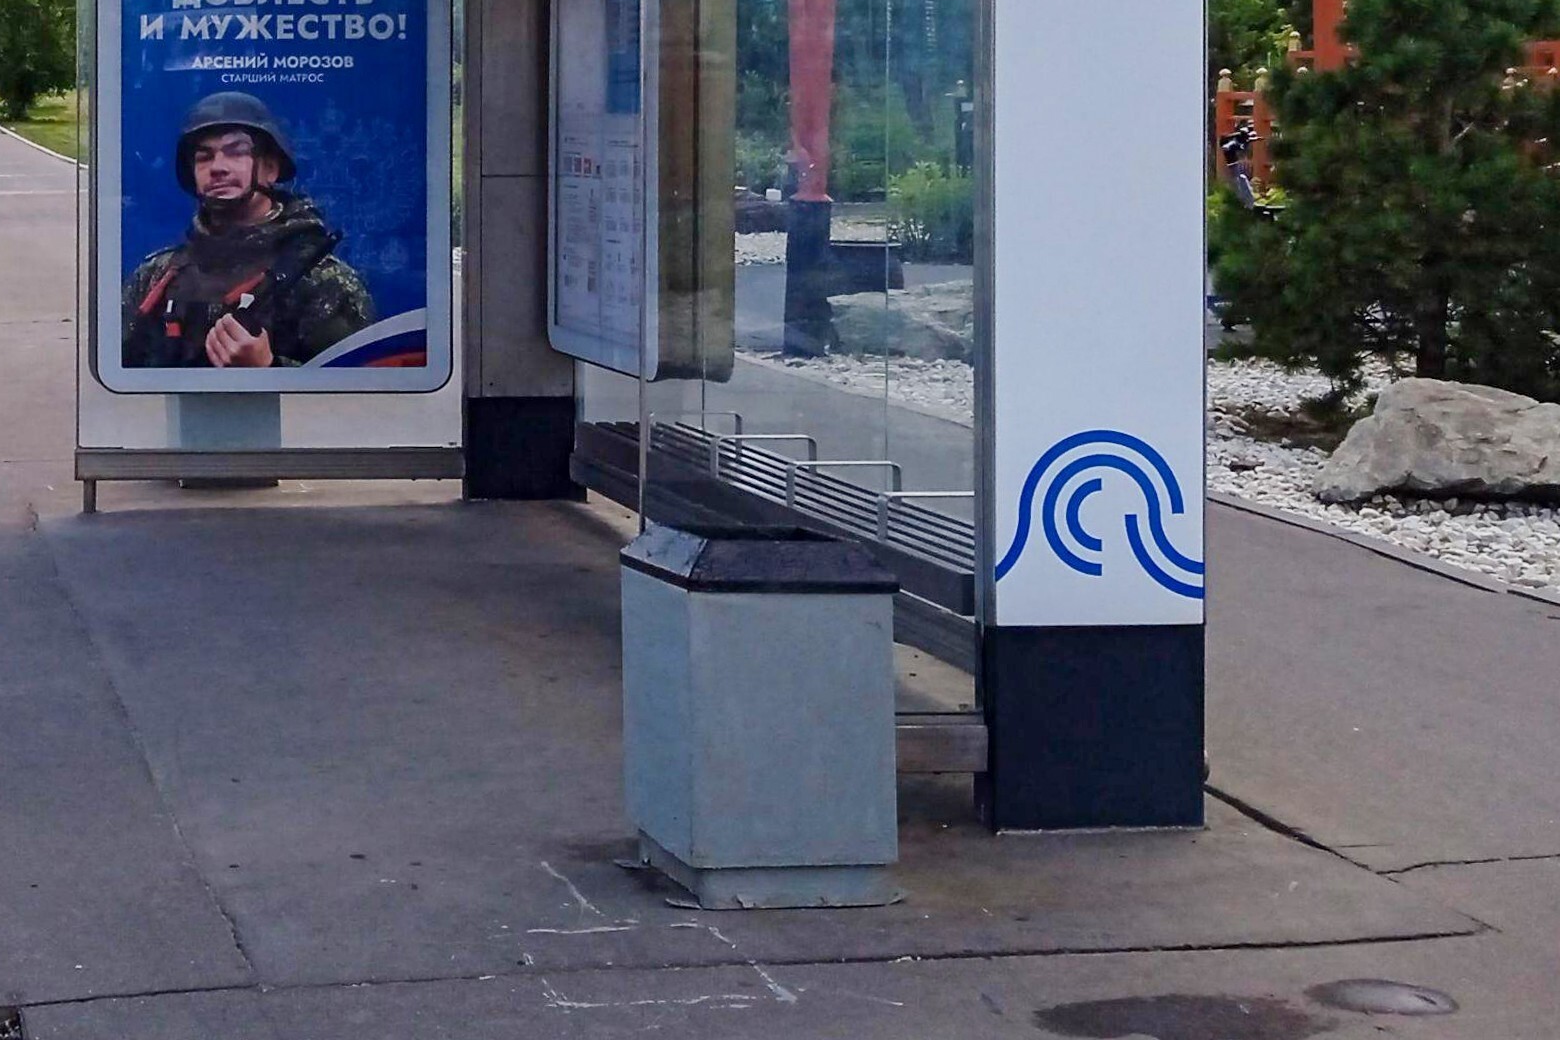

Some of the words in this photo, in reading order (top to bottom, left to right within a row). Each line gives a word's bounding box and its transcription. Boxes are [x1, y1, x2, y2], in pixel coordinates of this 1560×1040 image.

[140, 14, 164, 40] И
[181, 14, 407, 40] МУЖЕСТВО!
[191, 52, 268, 69] АРСЕНИЙ
[273, 55, 354, 69] МОРОЗОВ
[221, 72, 276, 83] СТАРШИЙ
[280, 73, 324, 83] МАТРОС
